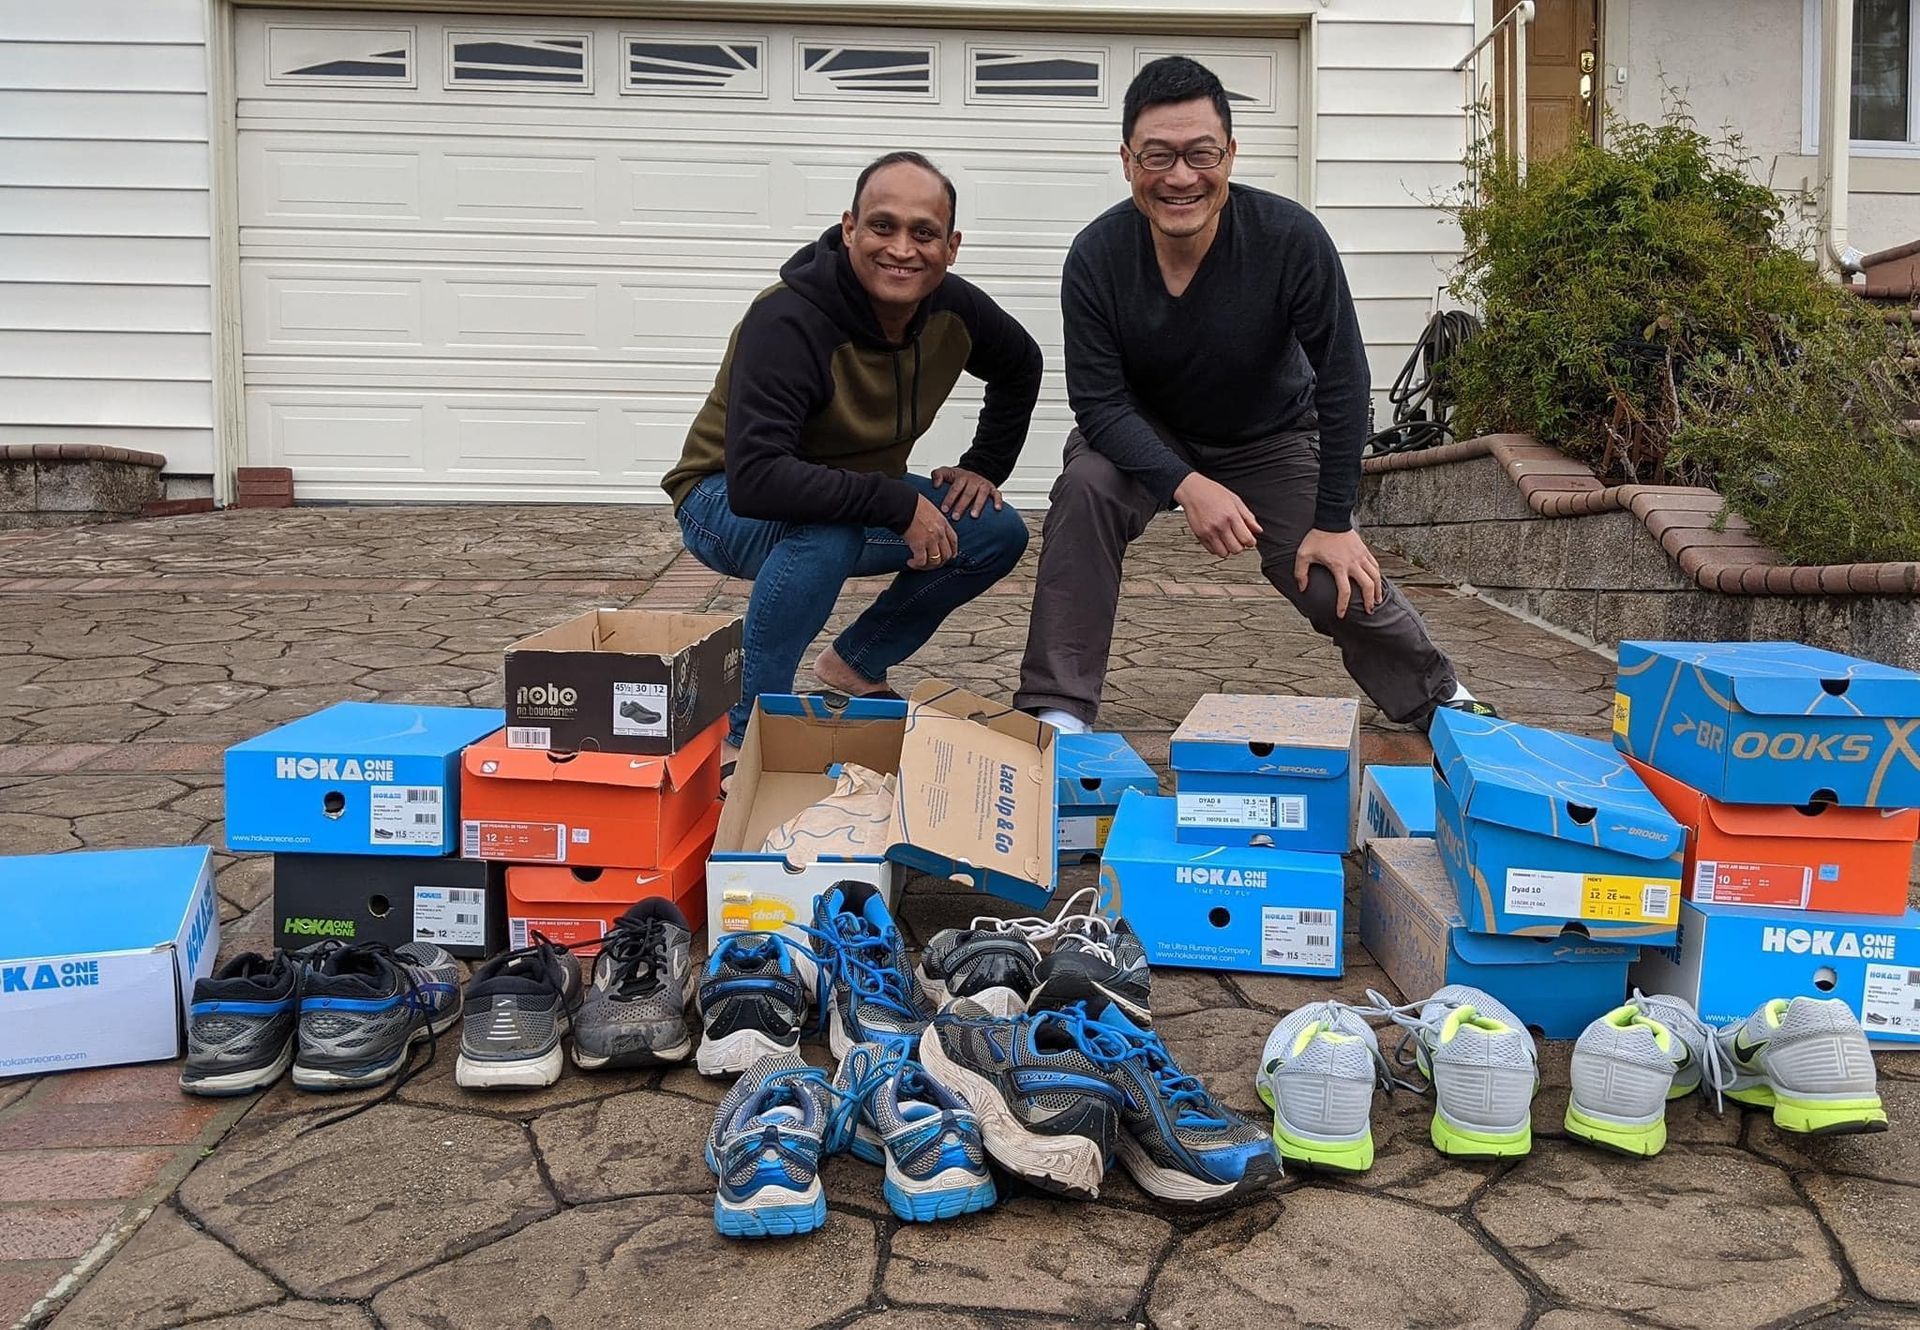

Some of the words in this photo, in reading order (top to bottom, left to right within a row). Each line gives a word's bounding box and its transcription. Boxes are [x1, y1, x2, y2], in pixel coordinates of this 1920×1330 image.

[516, 682, 578, 706] nobo
[635, 684, 647, 693] 30
[653, 685, 665, 694] 12
[275, 757, 364, 781] HOKA
[364, 759, 394, 771] ONE
[1278, 765, 1329, 775] BROOKS
[364, 770, 394, 782] ONE
[999, 763, 1017, 795] Lace
[994, 795, 1016, 817] Up
[996, 817, 1014, 831] &
[232, 833, 312, 844] www.hokaoneone.com
[486, 833, 498, 842] 12
[1627, 826, 1669, 842] BROOKS
[994, 832, 1014, 854] Go
[1175, 866, 1244, 887] HOKA
[1244, 870, 1268, 880] ONE
[1717, 874, 1731, 885] 10
[1243, 879, 1268, 888] ONE
[1511, 885, 1530, 894] Dyad
[1531, 886, 1541, 894] 10
[1194, 887, 1213, 895] TIME
[1589, 891, 1601, 900] 12
[1606, 892, 1618, 901] 2E
[283, 917, 336, 936] HOKA
[333, 920, 355, 929] ONE
[334, 928, 356, 937] ONE
[438, 929, 448, 938] 12
[1762, 926, 1861, 958] HOKA
[1862, 933, 1896, 947] ONE
[1157, 941, 1171, 950] The
[1171, 942, 1188, 951] Ultra
[1189, 943, 1217, 953] Running
[1218, 945, 1252, 956] Company
[1861, 946, 1895, 960] ONE
[1155, 950, 1236, 963] www.hokaoneone.com
[60, 960, 98, 975] ONE
[0, 964, 62, 993] KA
[61, 973, 99, 988] ONE
[1891, 1016, 1902, 1026] 12
